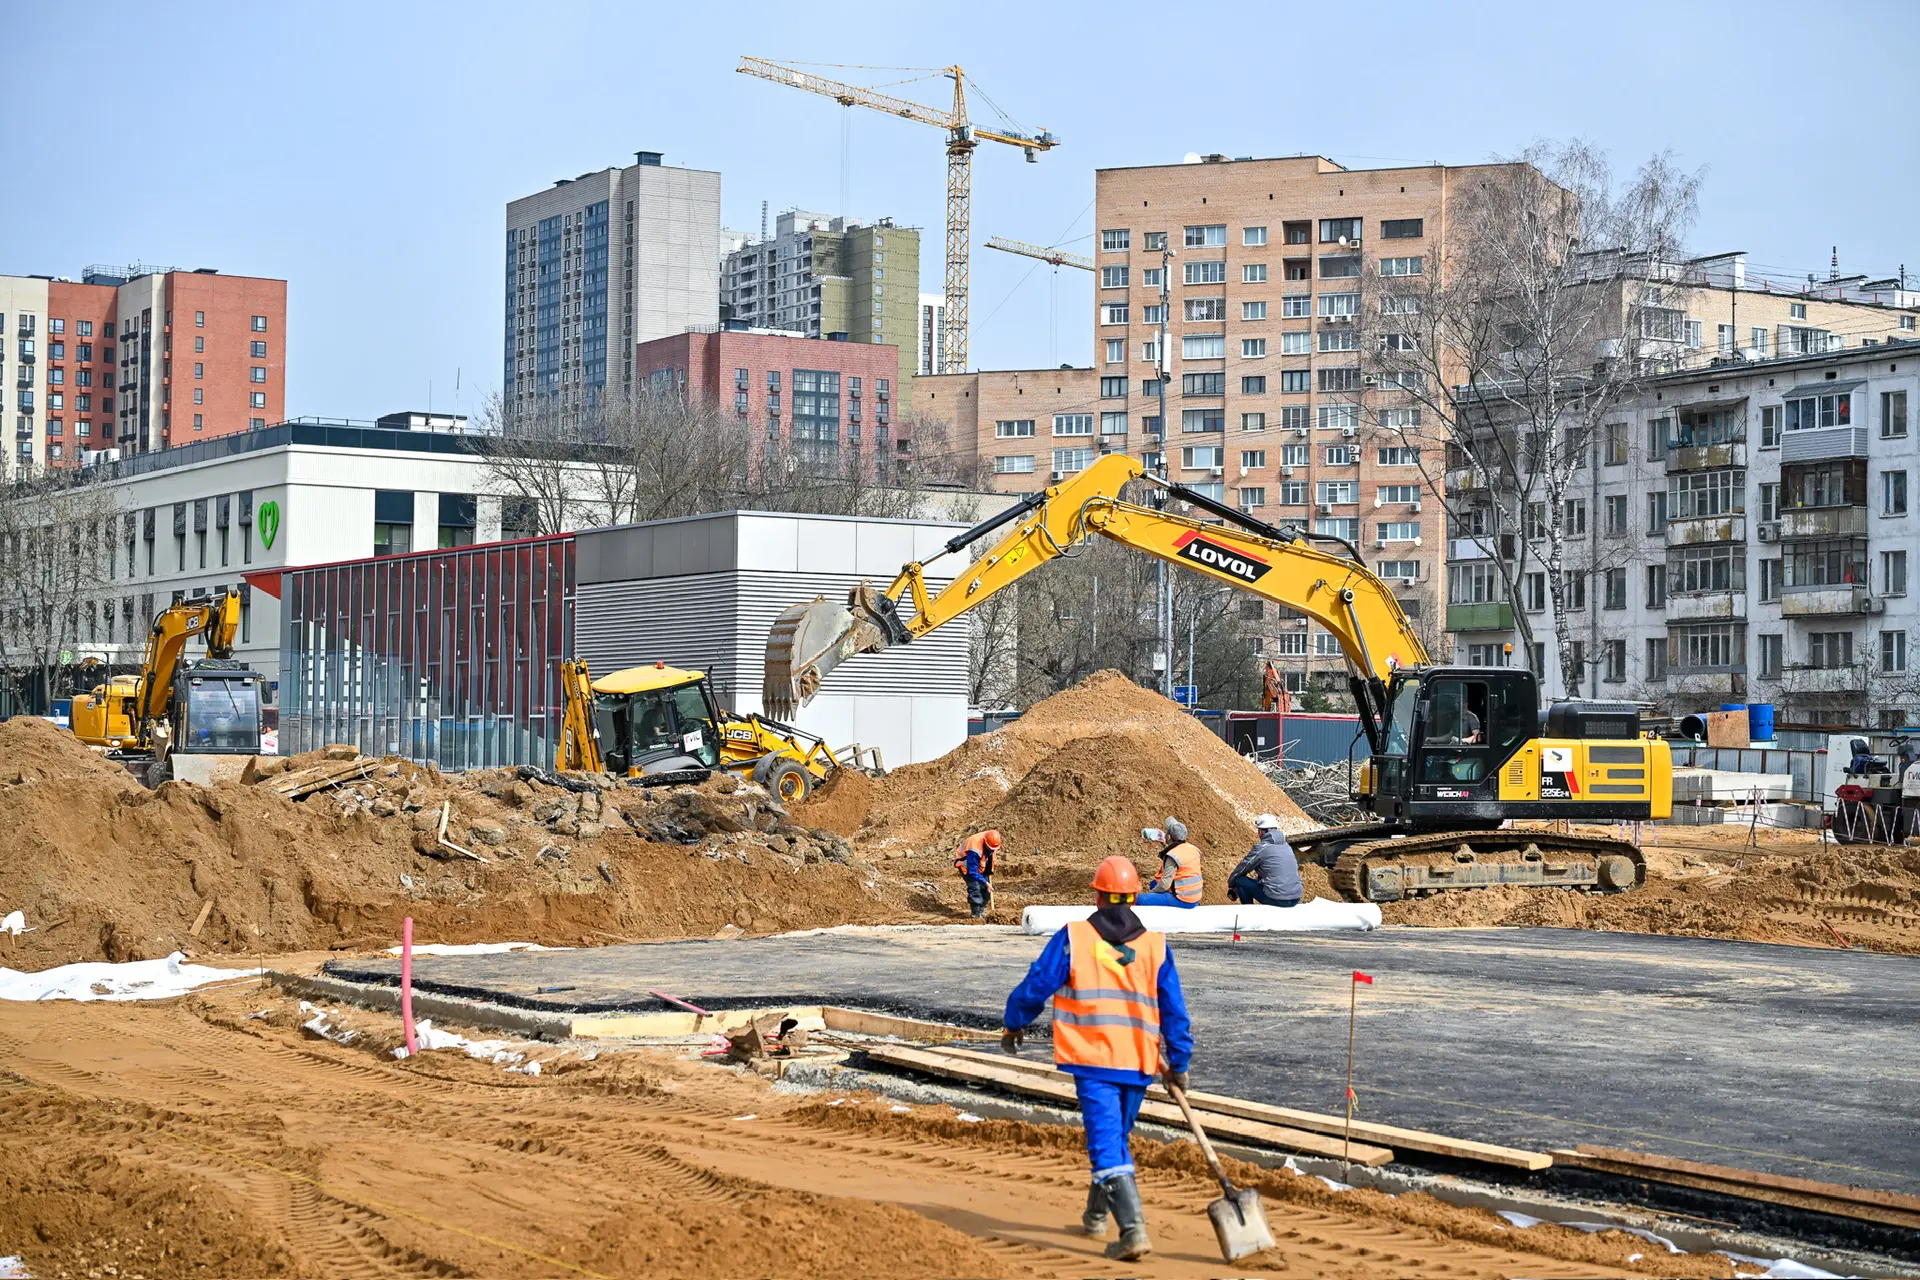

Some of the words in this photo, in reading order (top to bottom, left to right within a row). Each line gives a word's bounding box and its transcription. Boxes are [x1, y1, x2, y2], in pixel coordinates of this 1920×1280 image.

[1189, 543, 1257, 580] LOVOL
[186, 615, 199, 630] JCB
[726, 730, 752, 740] JCB
[1541, 777, 1553, 786] FR
